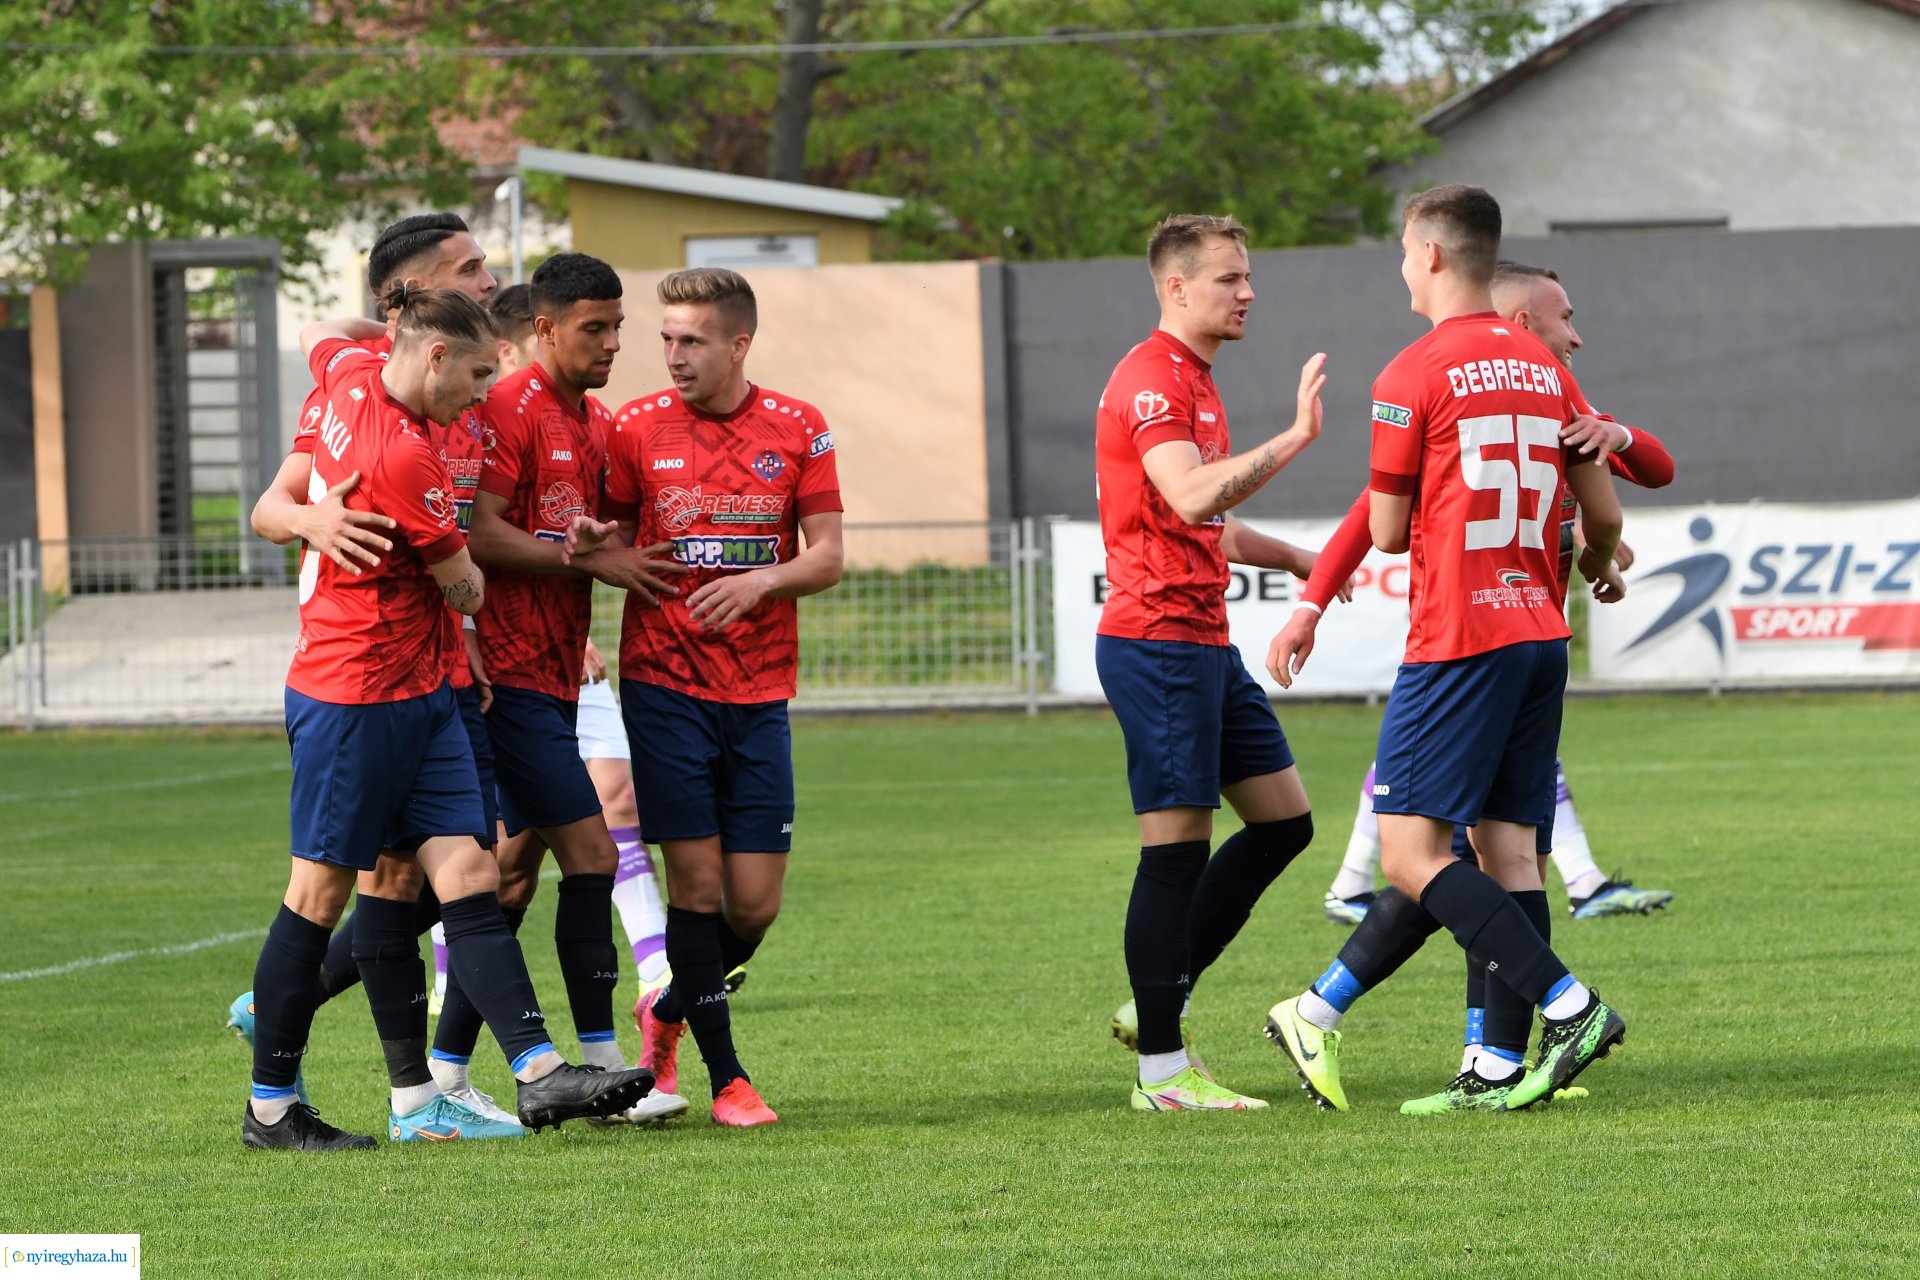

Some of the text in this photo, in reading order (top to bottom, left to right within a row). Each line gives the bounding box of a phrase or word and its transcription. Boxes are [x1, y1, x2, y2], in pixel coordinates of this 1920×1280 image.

[1446, 358, 1563, 398] DEBRECENI
[551, 449, 572, 461] JAKO
[652, 458, 685, 470] JAKO
[1456, 414, 1563, 552] 55
[700, 494, 787, 514] REVESZ
[1745, 607, 1859, 638] SPORT
[696, 990, 727, 1006] JAKO
